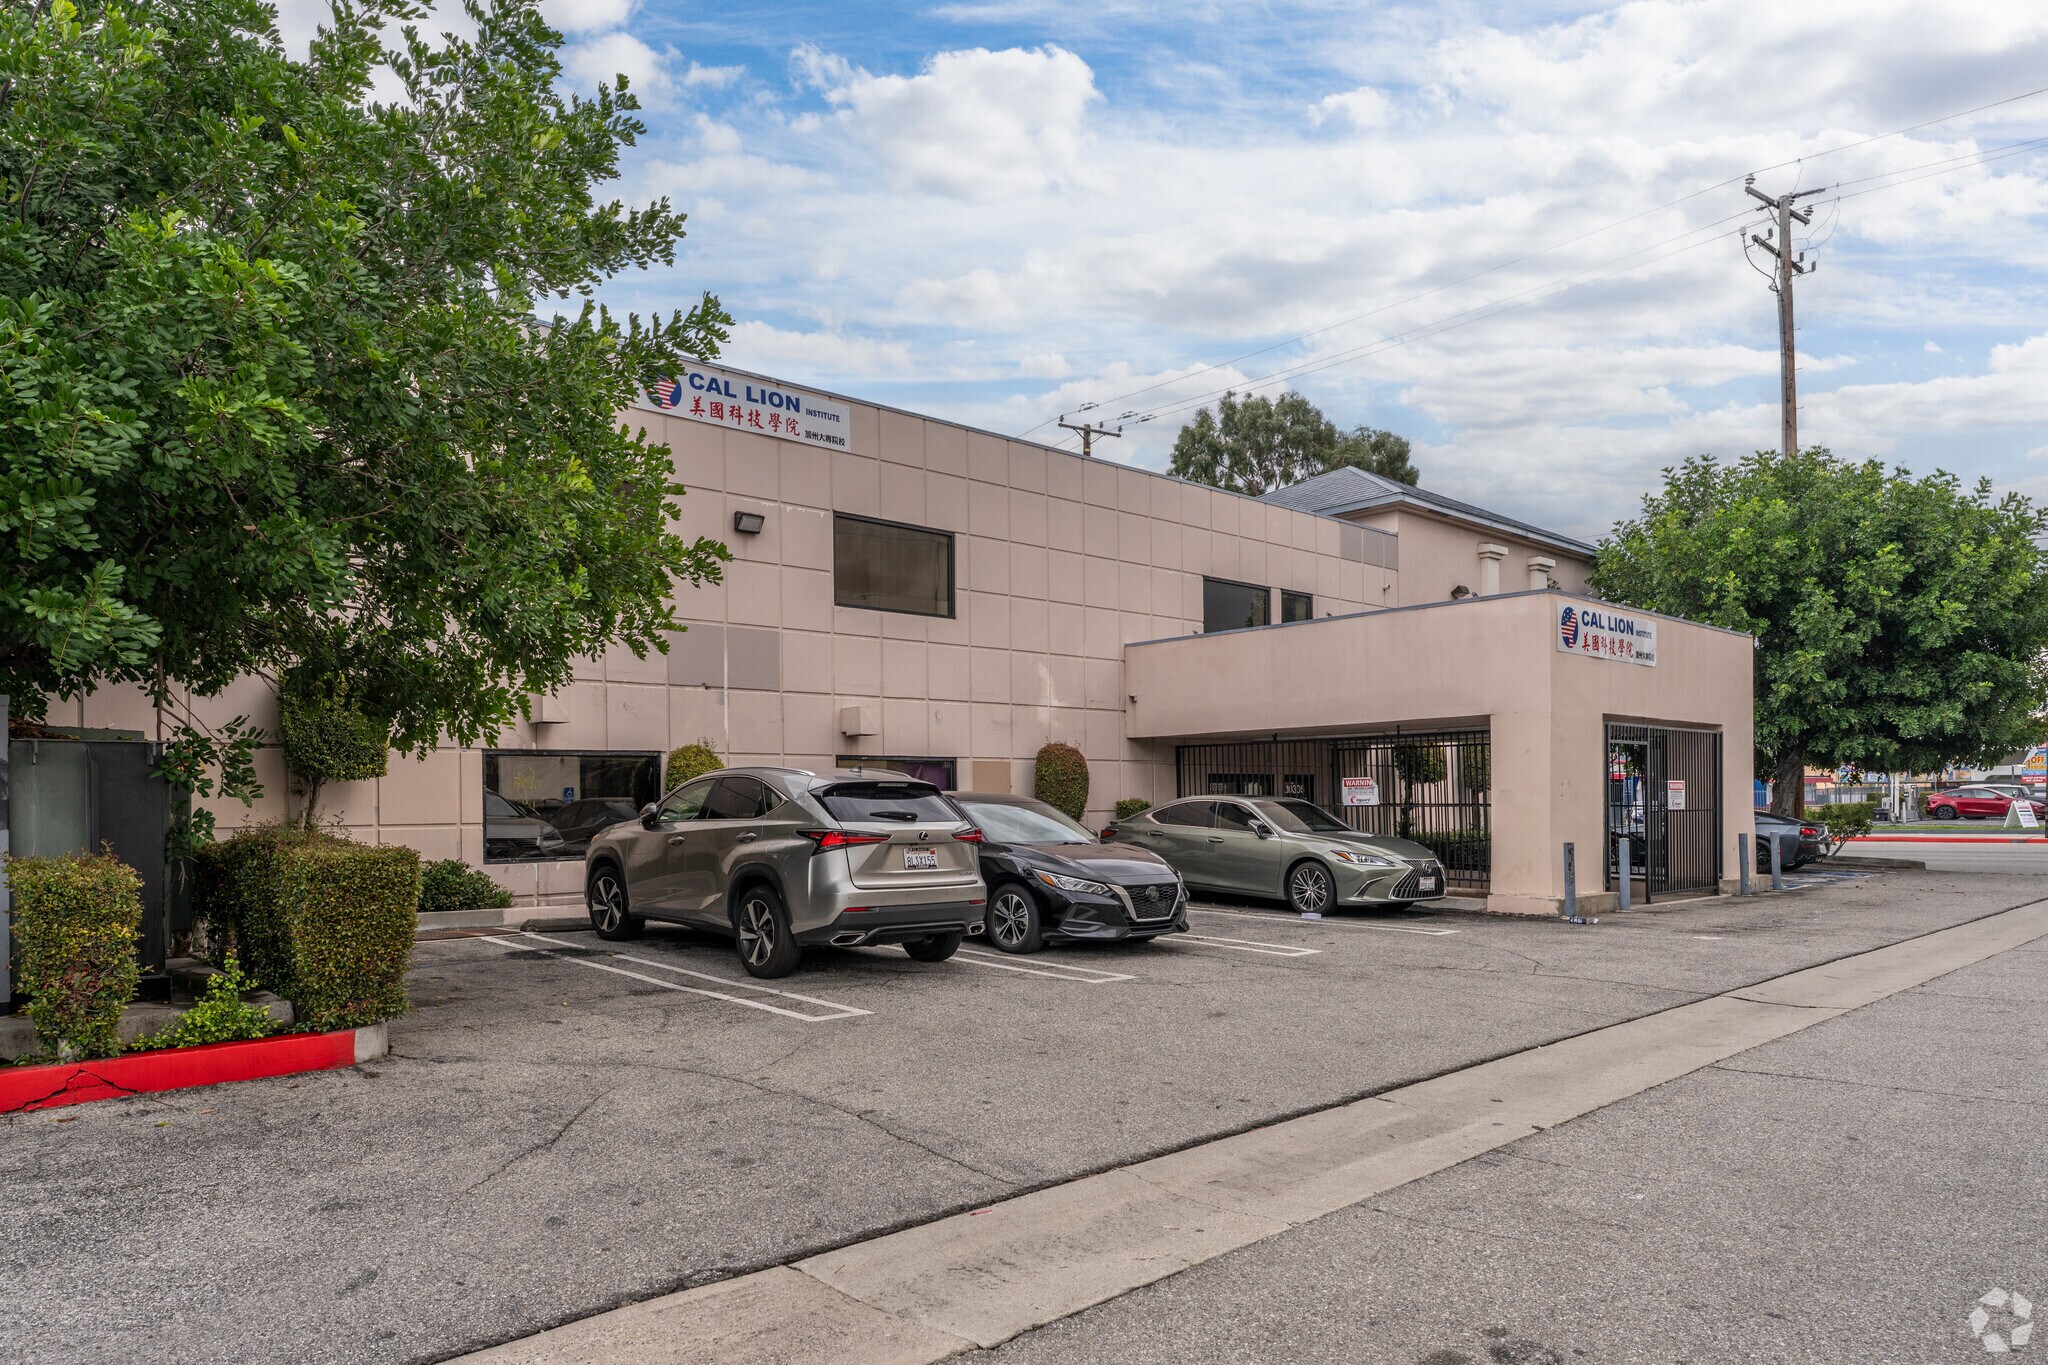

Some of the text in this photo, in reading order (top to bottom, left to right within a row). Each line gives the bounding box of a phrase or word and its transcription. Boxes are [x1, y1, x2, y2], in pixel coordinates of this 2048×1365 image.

[689, 372, 840, 423] CAL LION INSTITUTE
[689, 395, 800, 437] 美國科技學院
[1582, 610, 1605, 629] CAL
[1608, 616, 1634, 635] LION
[1581, 632, 1634, 658] 美國科技學院
[2030, 756, 2045, 764] OFF
